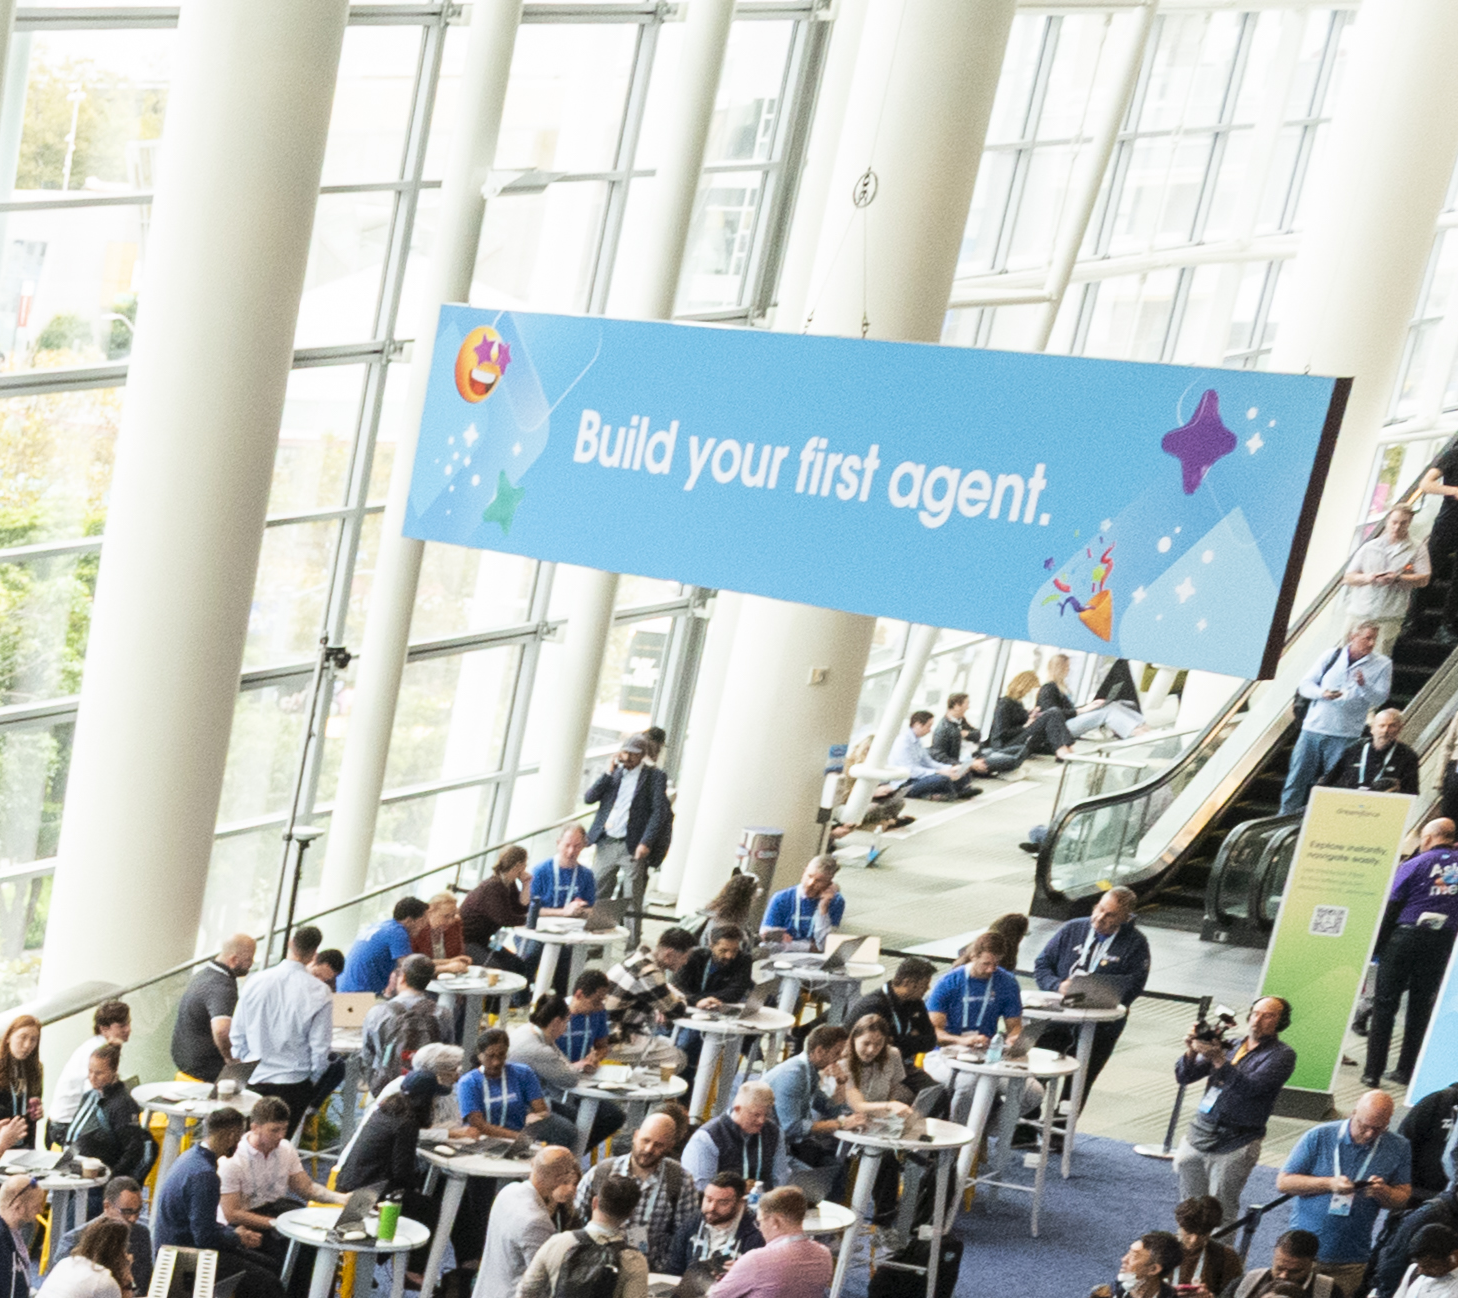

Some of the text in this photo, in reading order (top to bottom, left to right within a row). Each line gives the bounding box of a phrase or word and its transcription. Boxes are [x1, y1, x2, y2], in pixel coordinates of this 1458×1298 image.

[572, 409, 1052, 531] Build your first agent.
